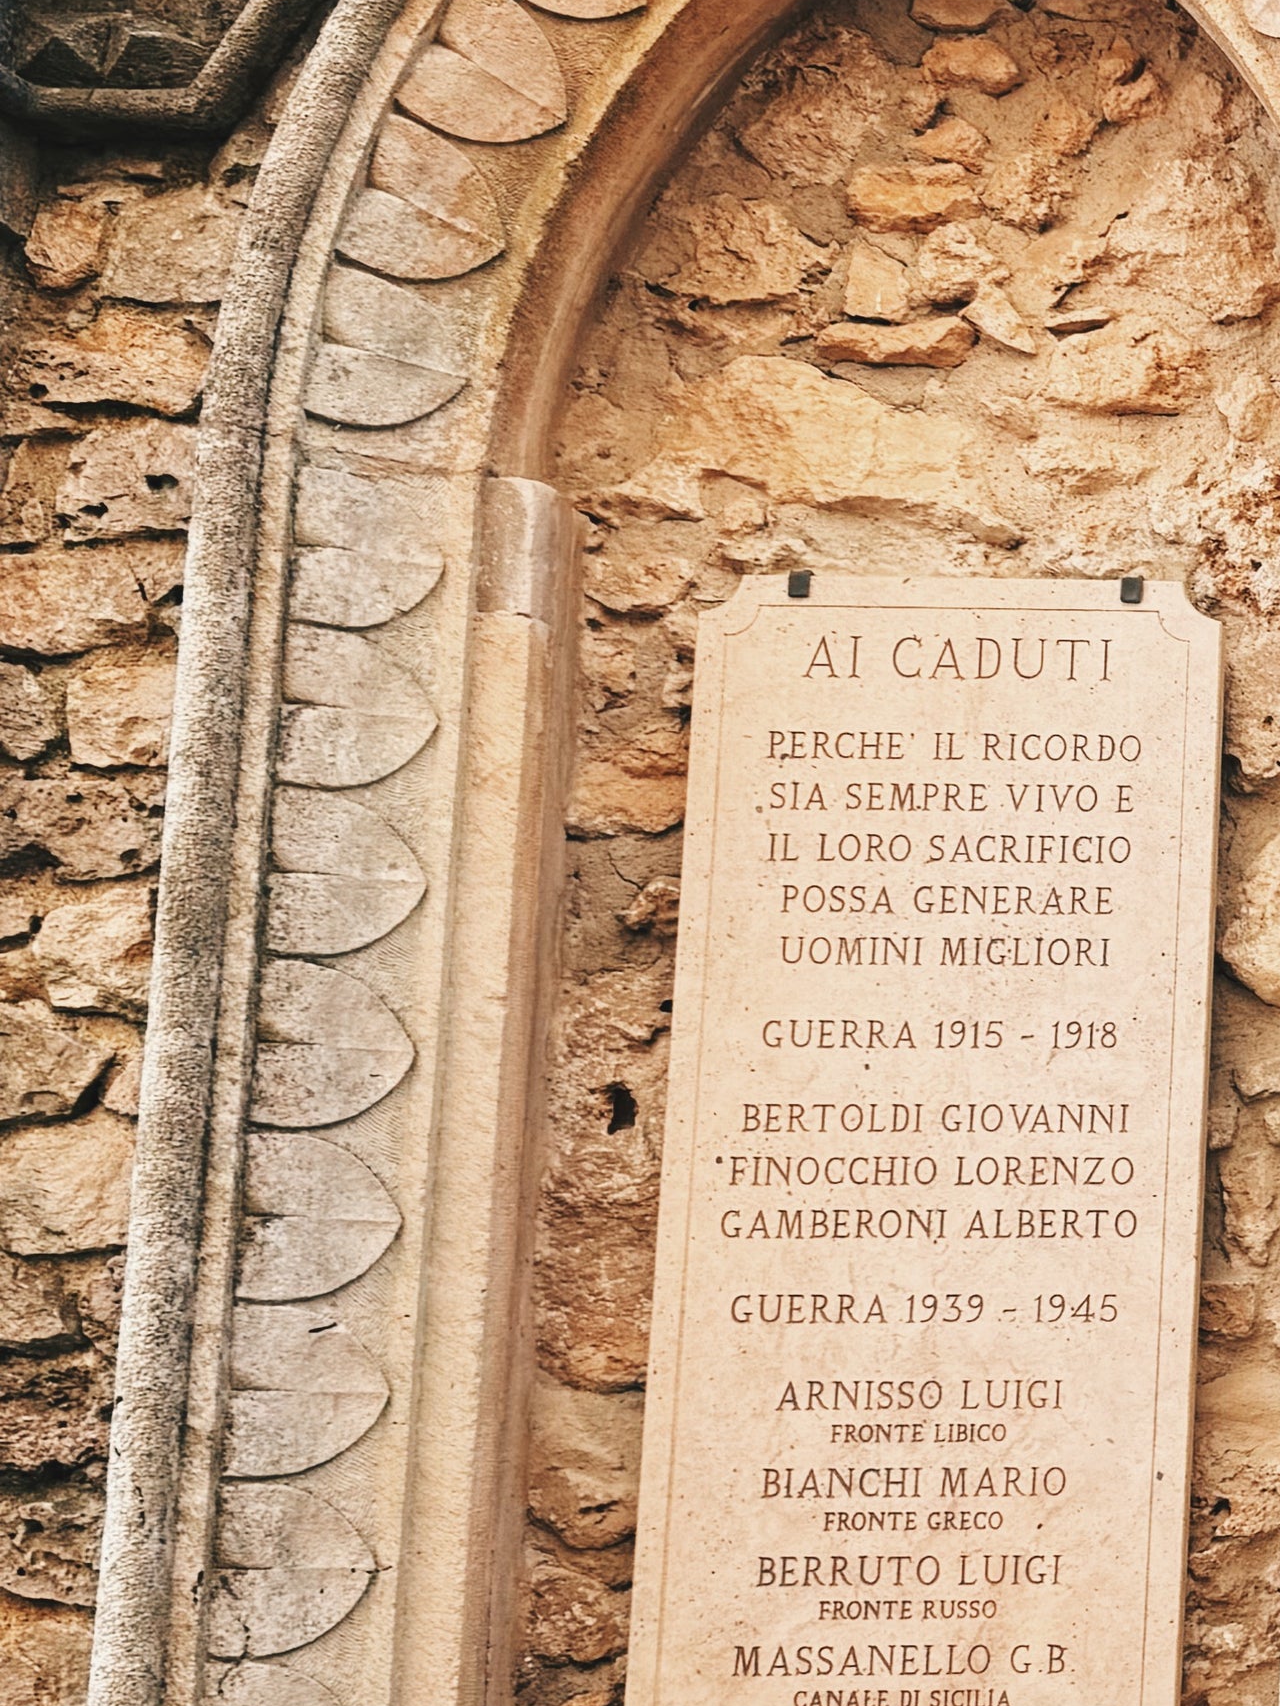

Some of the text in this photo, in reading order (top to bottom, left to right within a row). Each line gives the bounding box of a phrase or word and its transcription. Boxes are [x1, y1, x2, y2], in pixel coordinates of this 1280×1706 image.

[802, 635, 1112, 681] AI CADUTI
[767, 731, 1142, 763] PERCHE' IL RICORDO
[769, 785, 1134, 813] SIA SEMPRE VIVO E
[768, 834, 1131, 864] IL LORO SACRIFICIO
[781, 886, 1112, 915] POSSA GENERARE
[781, 936, 1110, 967] UOMINI MIGLIORI
[762, 1020, 914, 1049] GUERRA
[934, 1021, 1002, 1048] 1915
[1051, 1021, 1118, 1048] 1918
[742, 1103, 1128, 1133] BERTOLDI GIOVANNI
[729, 1156, 1134, 1185] FINOCCHIO LORENZO
[720, 1208, 1138, 1239] GAMBERONI ALBERTO
[731, 1294, 888, 1324] GUERRA
[905, 1295, 984, 1323] 1939
[1034, 1294, 1119, 1322] 1945
[776, 1381, 1062, 1411] ARNISSO LUIGI
[831, 1423, 1006, 1443] FRONTE LIBICO
[761, 1468, 1067, 1499] BIANCHI MARIO
[824, 1512, 1003, 1531] FRONTE GRECO
[756, 1555, 1062, 1587] BERRUTO LUIGI
[818, 1600, 998, 1621] FRONTE RUSSO
[732, 1645, 991, 1677] MASSANELLO
